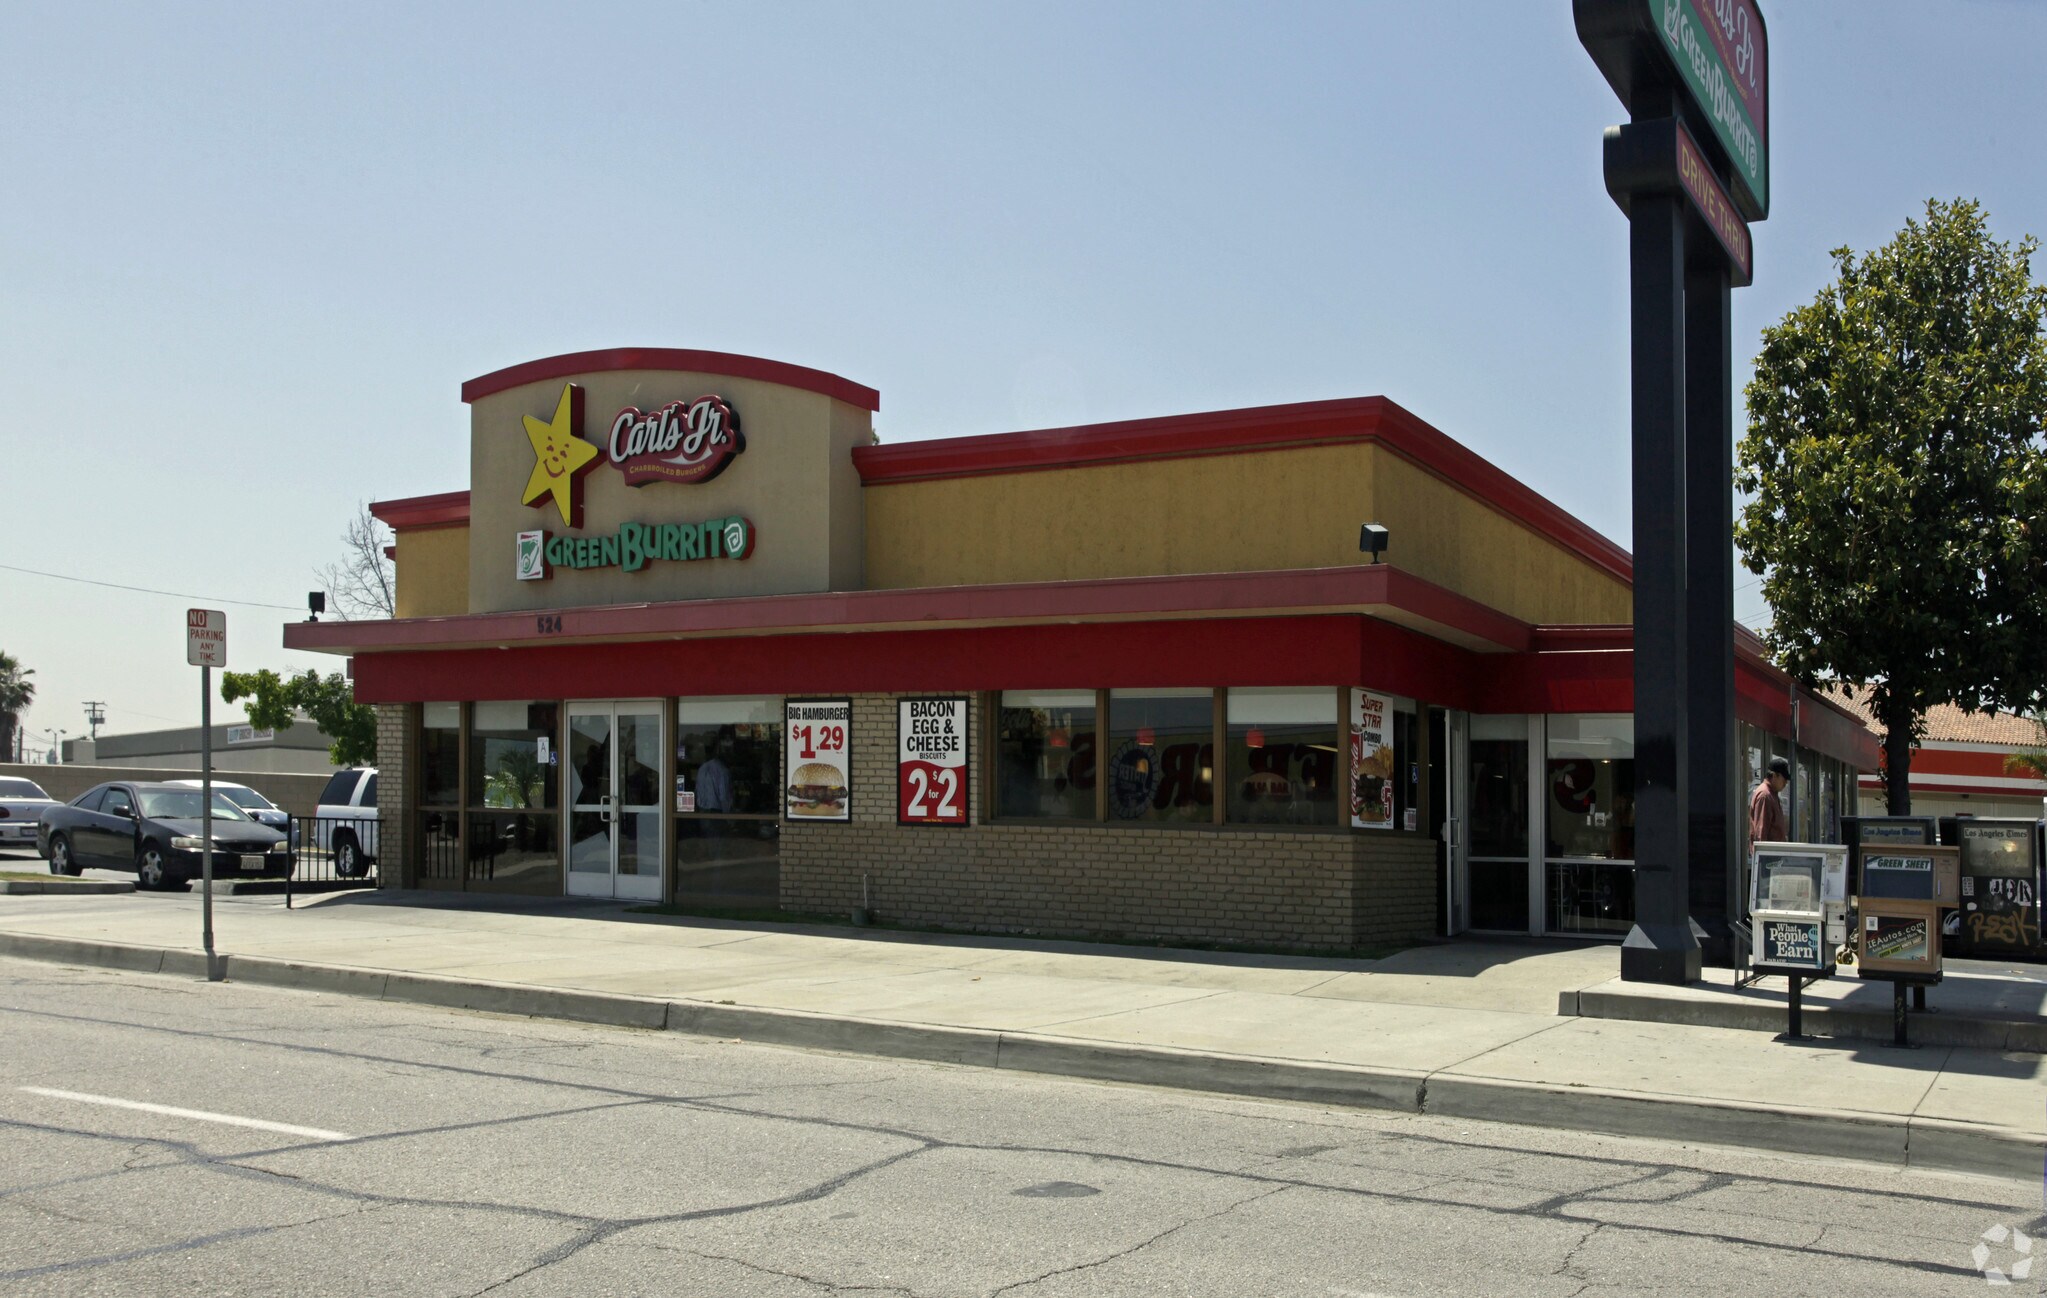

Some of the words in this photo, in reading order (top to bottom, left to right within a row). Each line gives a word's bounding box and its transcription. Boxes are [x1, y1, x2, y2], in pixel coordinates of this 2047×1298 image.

[1682, 144, 1715, 218] DRIVE
[1719, 202, 1745, 262] THRU
[610, 403, 683, 463] Carl's
[629, 465, 675, 476] CHARBROILED
[675, 464, 706, 476] BURGERS
[190, 611, 205, 626] NO
[538, 616, 563, 634] 524
[190, 629, 224, 642] PARKING
[200, 642, 214, 651] ANY
[199, 652, 215, 662] TIME
[910, 701, 955, 717] BACON
[1361, 694, 1383, 712] SUPER
[788, 706, 801, 720] BIG
[802, 707, 848, 720] HAMBURGER
[912, 719, 939, 735] EGG
[943, 718, 954, 735] &
[1362, 713, 1381, 730] STAR
[792, 724, 844, 758] $1.29
[906, 736, 959, 752] CHEESE
[1363, 730, 1382, 744] COMBO
[919, 752, 946, 760] BISCUITS
[908, 768, 928, 817] 2
[928, 789, 939, 799] for
[1964, 827, 1977, 837] Los
[1978, 827, 2004, 839] Angeles
[2006, 827, 2028, 838] Times
[1877, 858, 1904, 869] GREEN
[1905, 859, 1930, 870] SHEET
[1776, 923, 1797, 932] What
[1867, 921, 1925, 948] IEAutos.com
[1769, 927, 1808, 945] People
[1776, 941, 1814, 959] Earn
